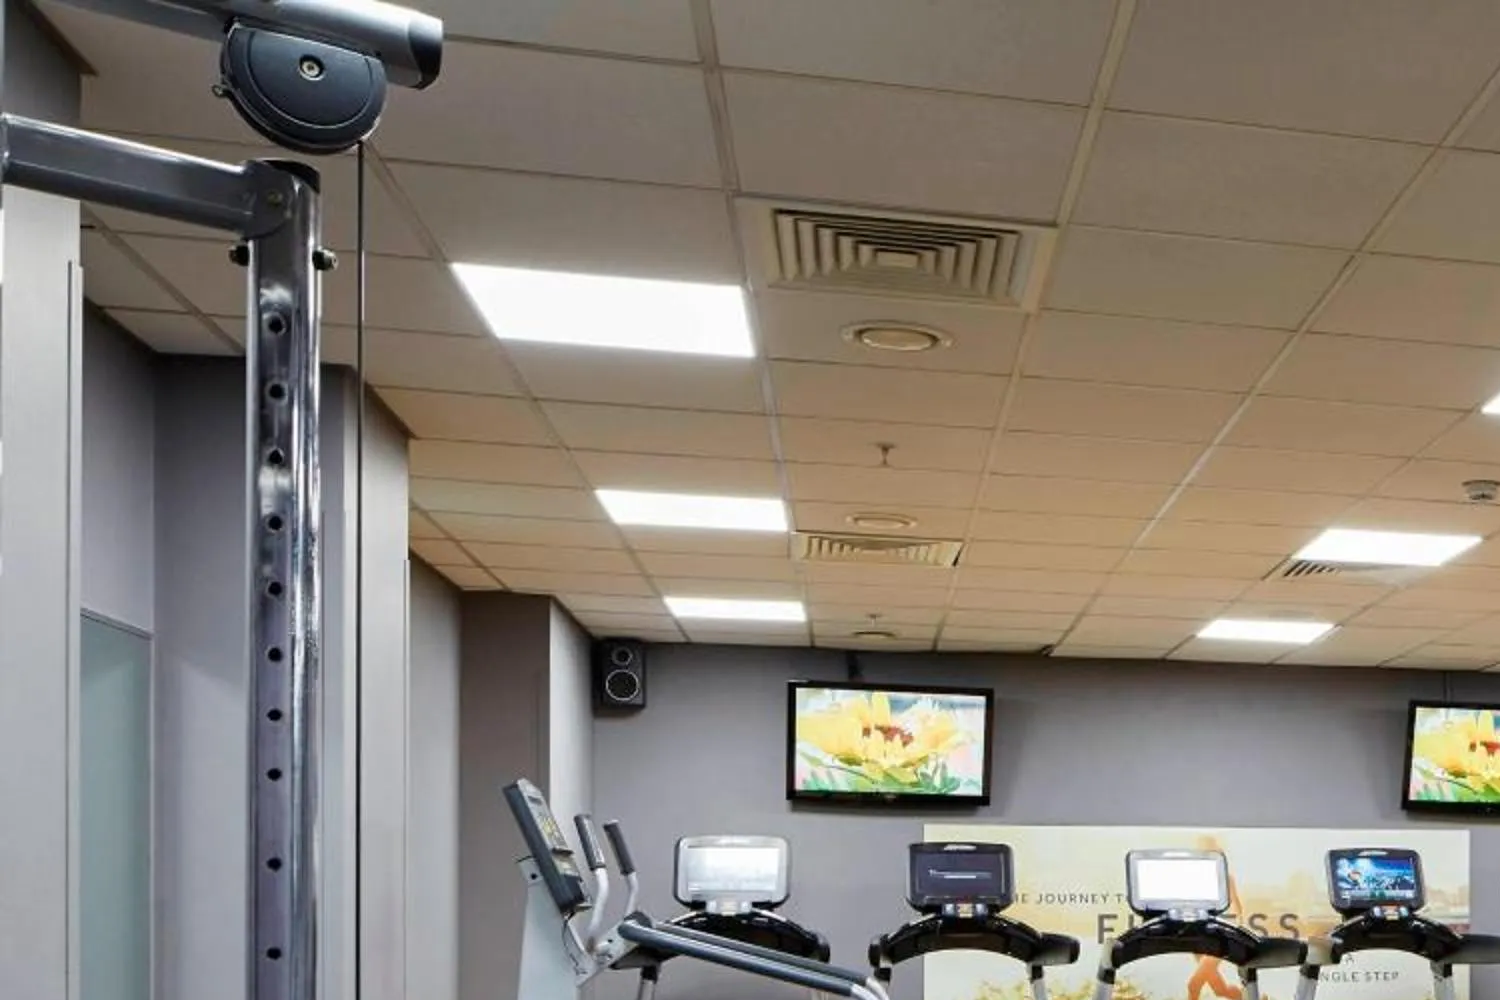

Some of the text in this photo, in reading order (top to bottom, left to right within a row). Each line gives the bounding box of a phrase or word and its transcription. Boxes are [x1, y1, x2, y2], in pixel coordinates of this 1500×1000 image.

[1036, 893, 1109, 905] JOURNEY
[1321, 971, 1399, 982] NGLE STEP
